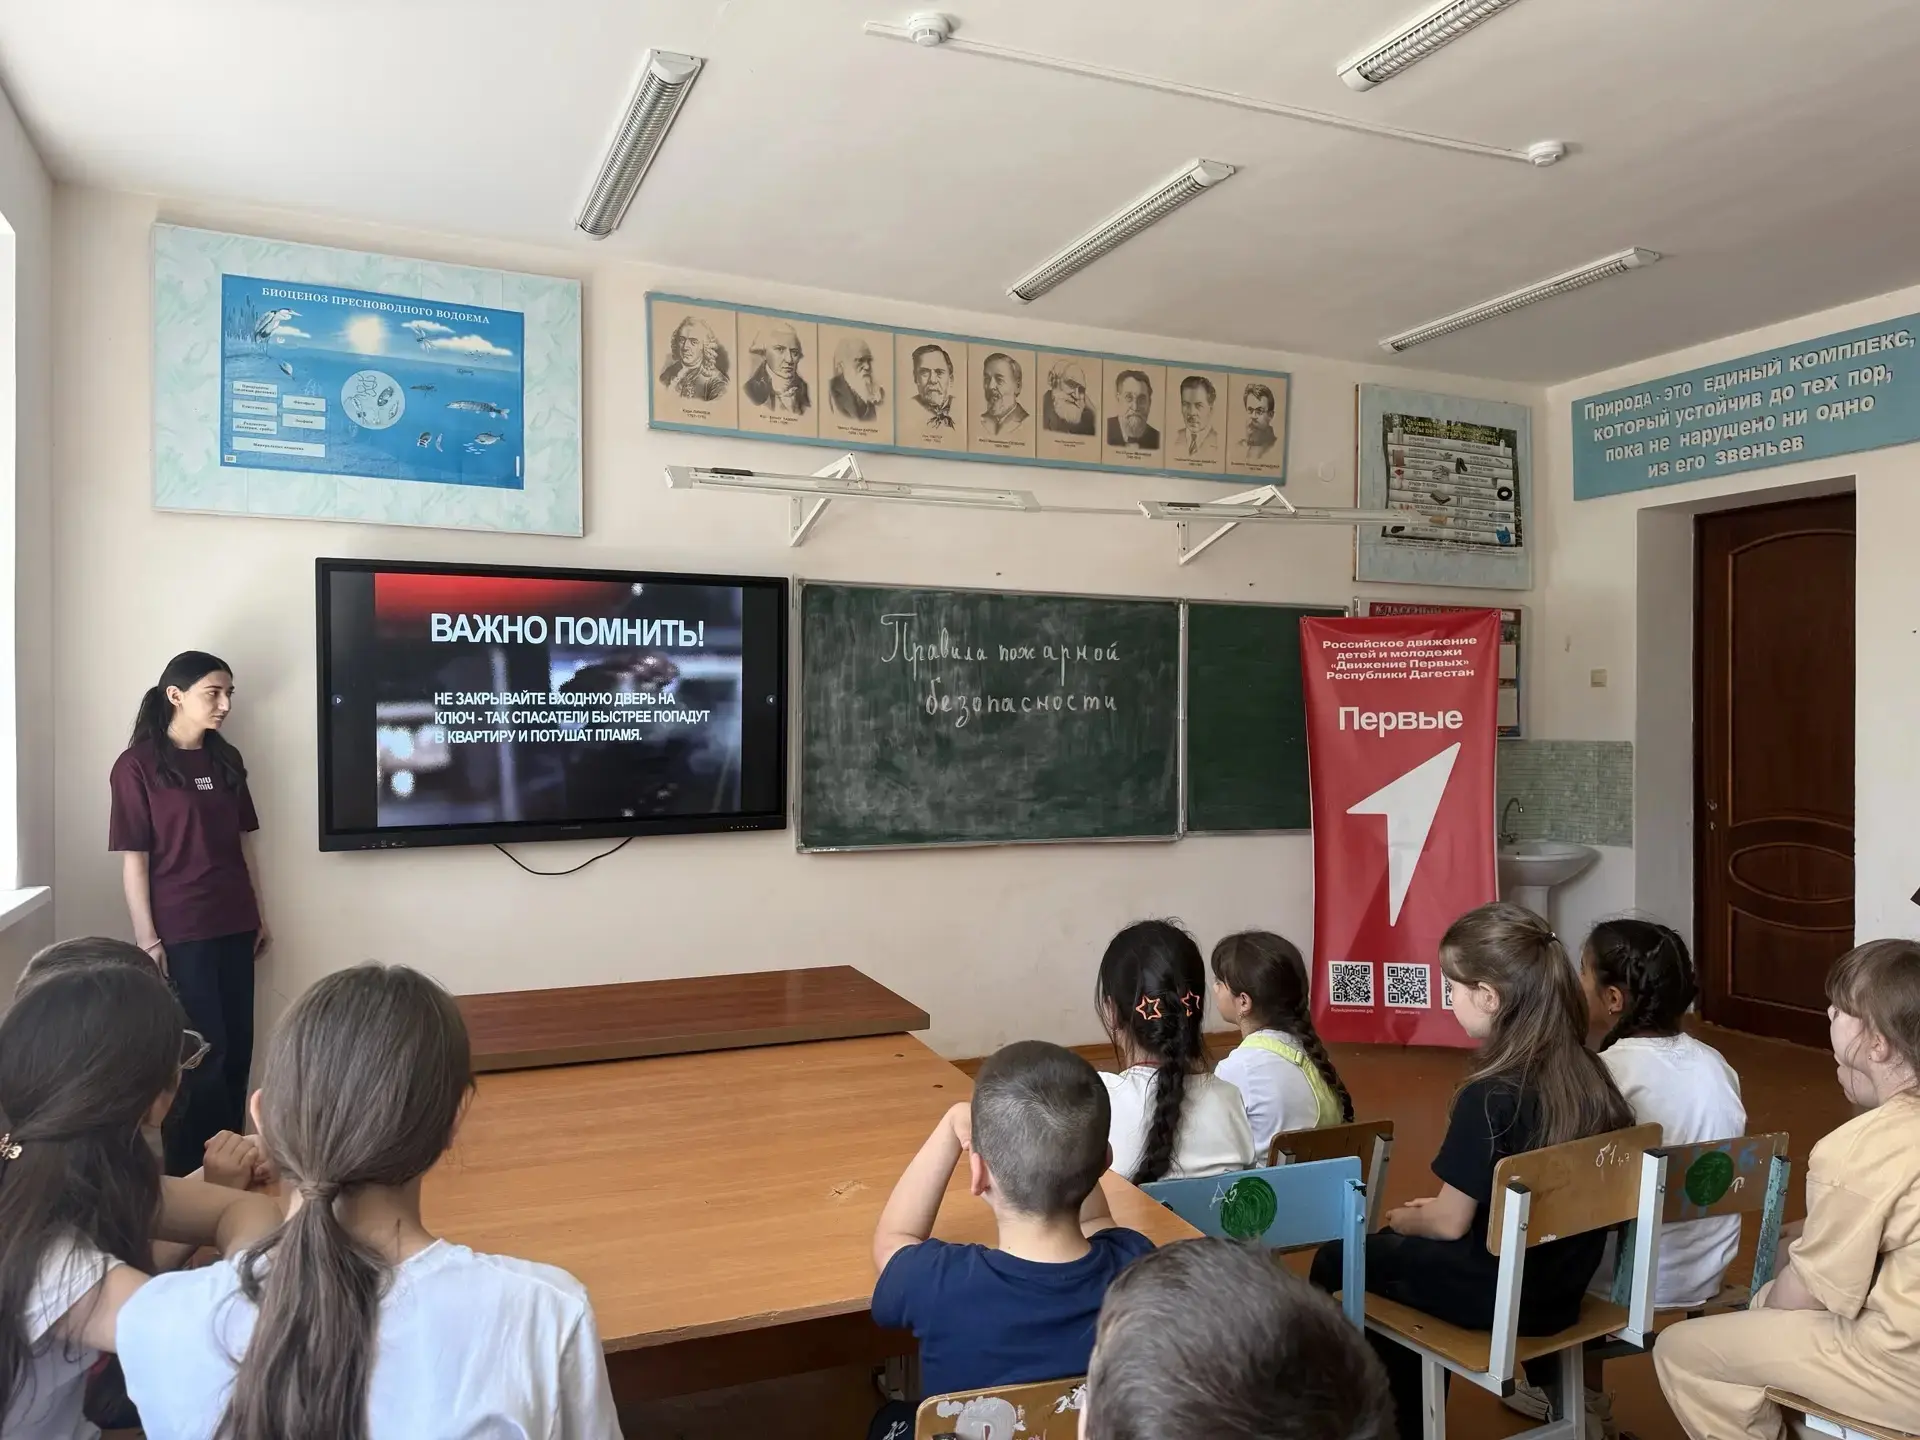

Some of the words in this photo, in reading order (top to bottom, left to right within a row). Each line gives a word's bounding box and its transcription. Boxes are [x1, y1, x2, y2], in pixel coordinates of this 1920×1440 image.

[262, 287, 329, 303] БИОЦЕНОЗ
[331, 295, 433, 317] ПРЕСНОВОДНОГО
[436, 309, 491, 324] ВОДОЕМА
[1594, 408, 1671, 442] который
[1675, 392, 1763, 428] устойчив
[1769, 384, 1796, 408] до
[1801, 374, 1840, 397] тех
[1848, 363, 1894, 387] пор,
[1605, 441, 1644, 463] пока
[1649, 436, 1670, 454] не
[1680, 414, 1777, 448] нарушено
[1782, 408, 1808, 428] ни
[1816, 395, 1876, 422] одно
[1648, 462, 1670, 478] из
[1675, 454, 1706, 473] его
[1715, 435, 1804, 466] звеньев
[430, 612, 548, 645] ВАЖНО
[554, 616, 704, 647] ПОМНИТЬ!
[1323, 640, 1404, 649] Российское
[1407, 637, 1477, 648] движение
[880, 612, 989, 682] Правила
[998, 640, 1120, 687] пожарной
[1331, 660, 1407, 671] «Движение
[1409, 659, 1470, 669] Первых»
[1336, 650, 1377, 660] детей
[1390, 649, 1462, 659] молодежи
[1326, 671, 1407, 682] Республики
[1409, 669, 1475, 680] Дагестан
[434, 692, 453, 705] НЕ
[455, 689, 546, 706] ЗАКРЫВАЙТЕ
[549, 692, 612, 707] ВХОДНУЮ
[614, 692, 656, 708] ДВЕРЬ
[658, 693, 675, 705] НА
[925, 676, 1118, 728] безопасности
[434, 711, 475, 725] КЛЮЧ
[485, 711, 510, 724] ТАК
[511, 710, 589, 724] СПАСАТЕЛИ
[591, 710, 652, 724] БЫСТРЕЕ
[653, 709, 710, 725] ПОПАДУТ
[1338, 706, 1464, 738] Первые
[434, 730, 445, 744] В
[447, 730, 516, 744] КВАРТИРУ
[518, 730, 528, 743] И
[530, 729, 593, 742] ПОТУШАТ
[595, 728, 643, 742] ПЛАМЯ.
